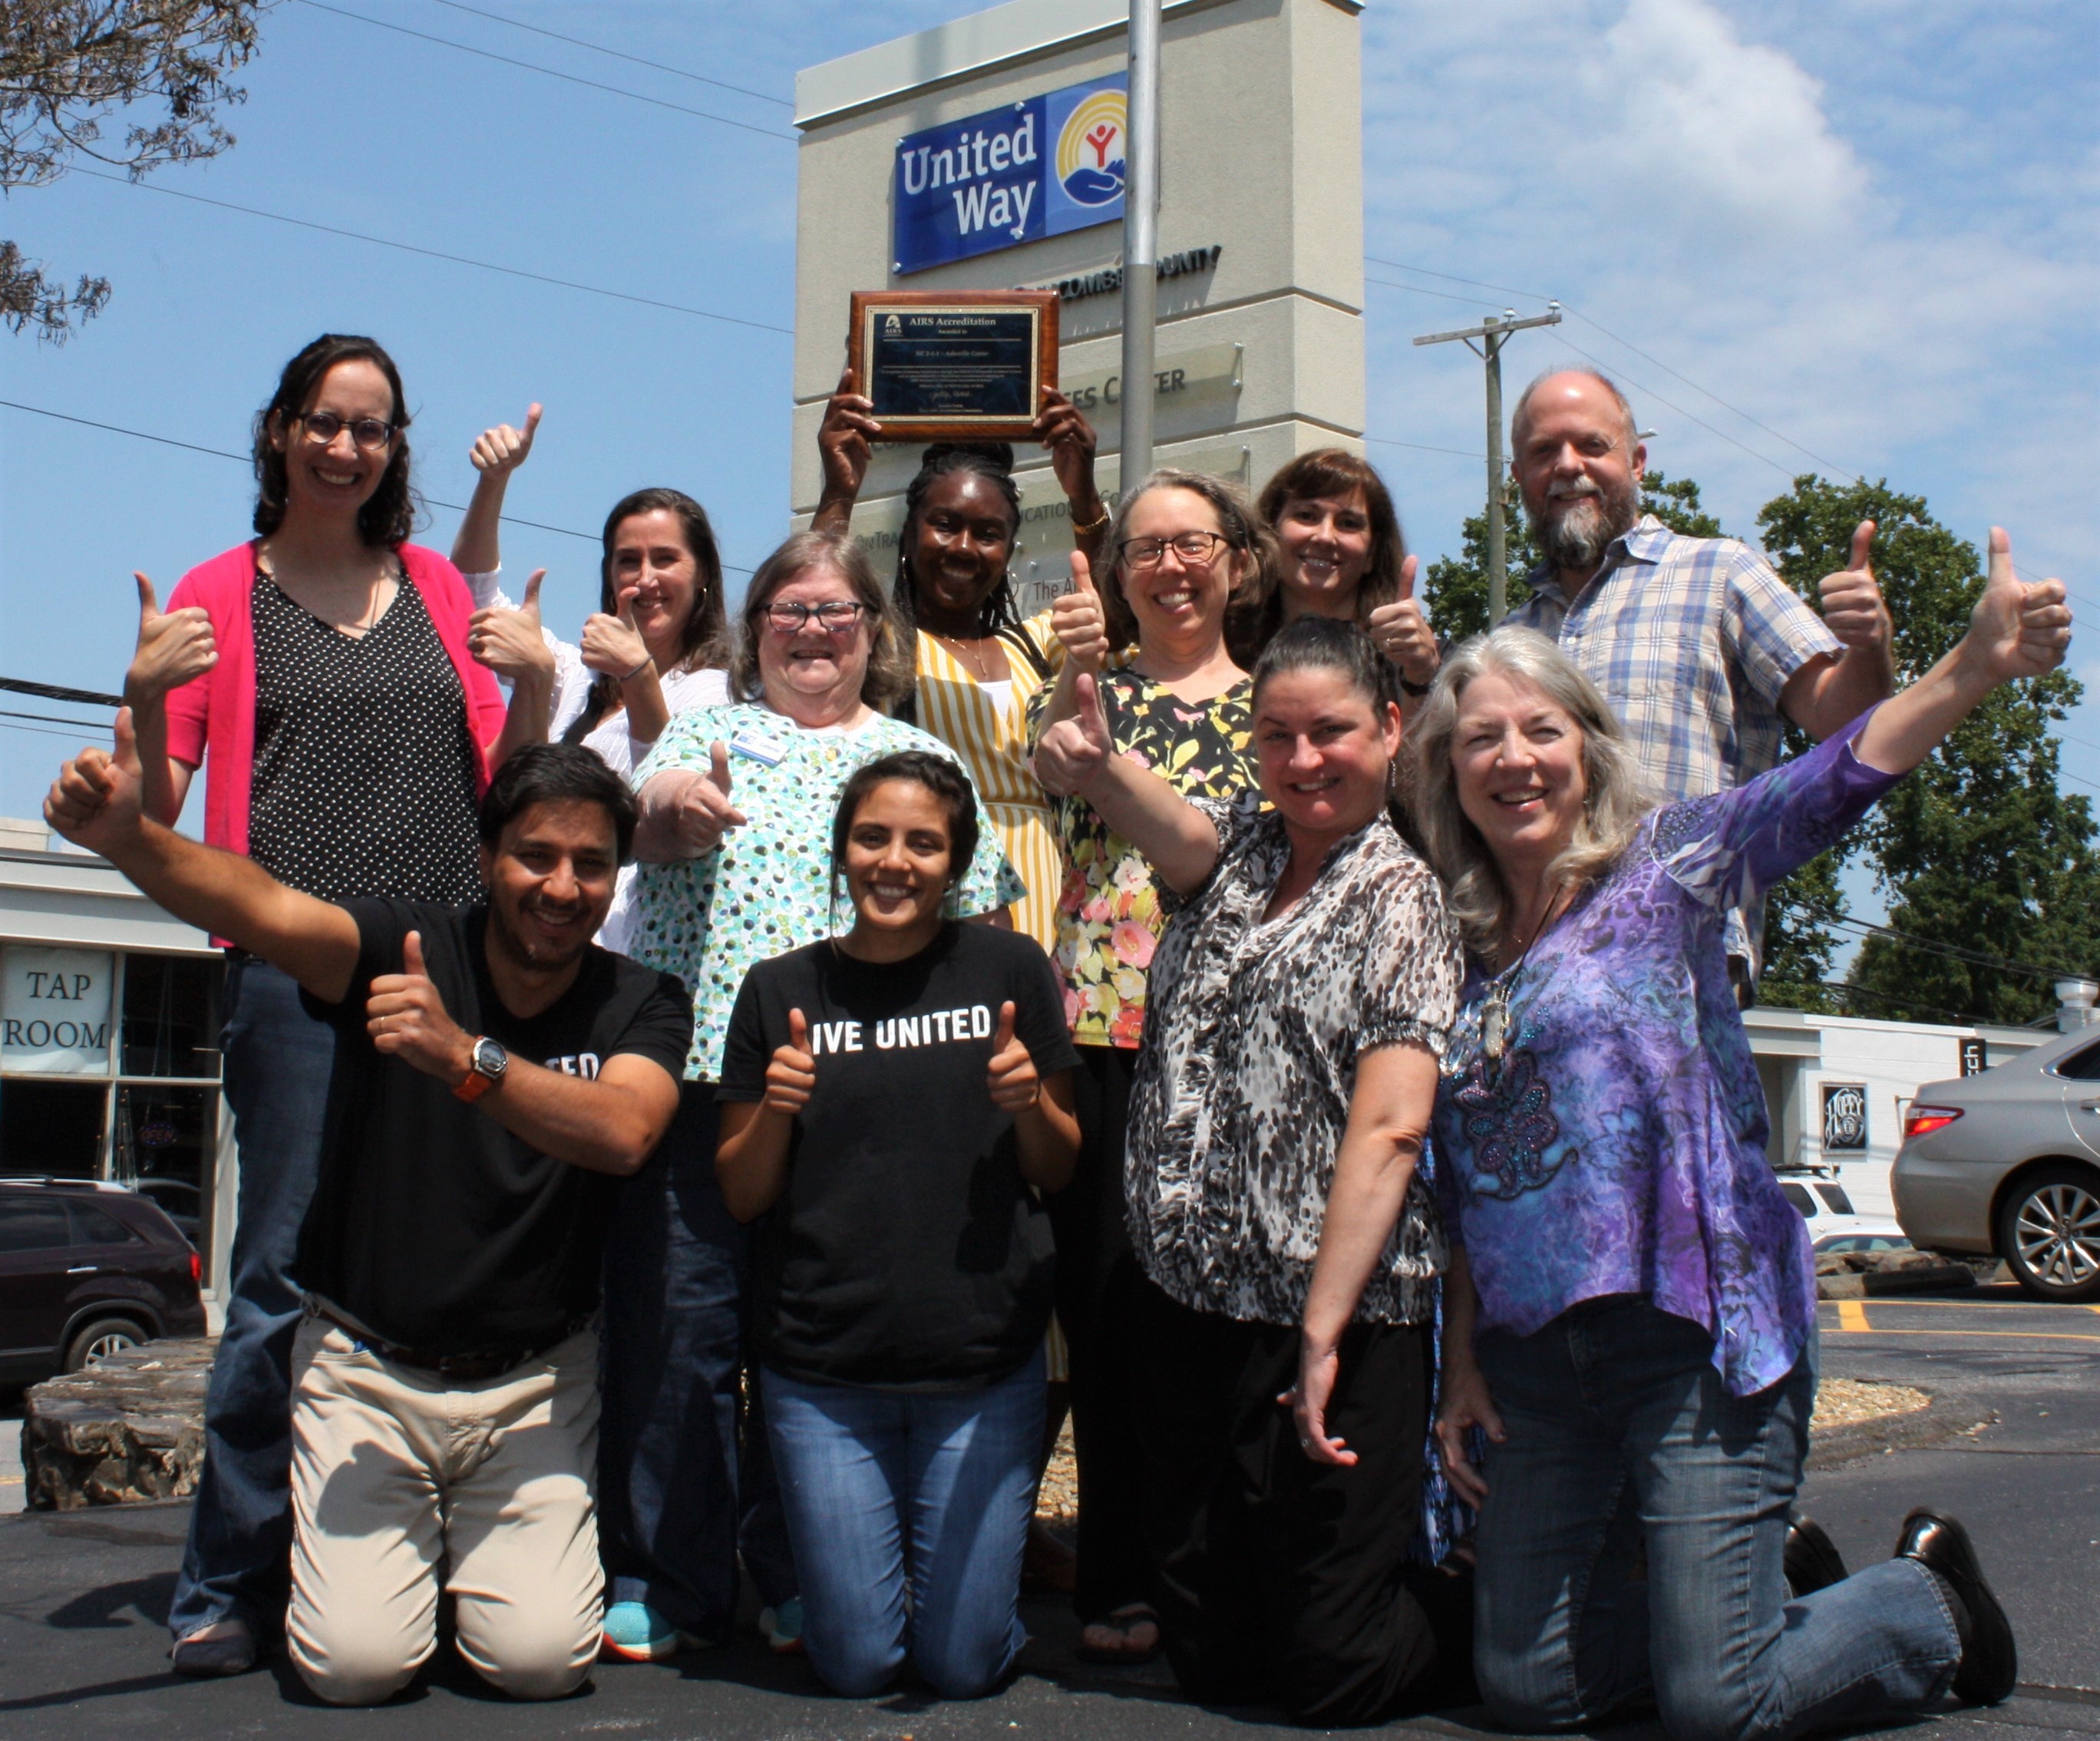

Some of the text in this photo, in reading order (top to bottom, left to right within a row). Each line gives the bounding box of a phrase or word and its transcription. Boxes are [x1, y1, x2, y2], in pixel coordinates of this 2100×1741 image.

[902, 114, 1036, 195] United
[953, 180, 1036, 236] Way
[1157, 245, 1222, 279] UNTY
[936, 317, 996, 325] Accreditation
[1104, 368, 1187, 405] CTER
[1033, 576, 1077, 602] The A
[27, 972, 91, 999] TAP
[3, 1019, 107, 1049] ROOM
[812, 1004, 991, 1056] IVE UNITED
[544, 1052, 599, 1081] TED
